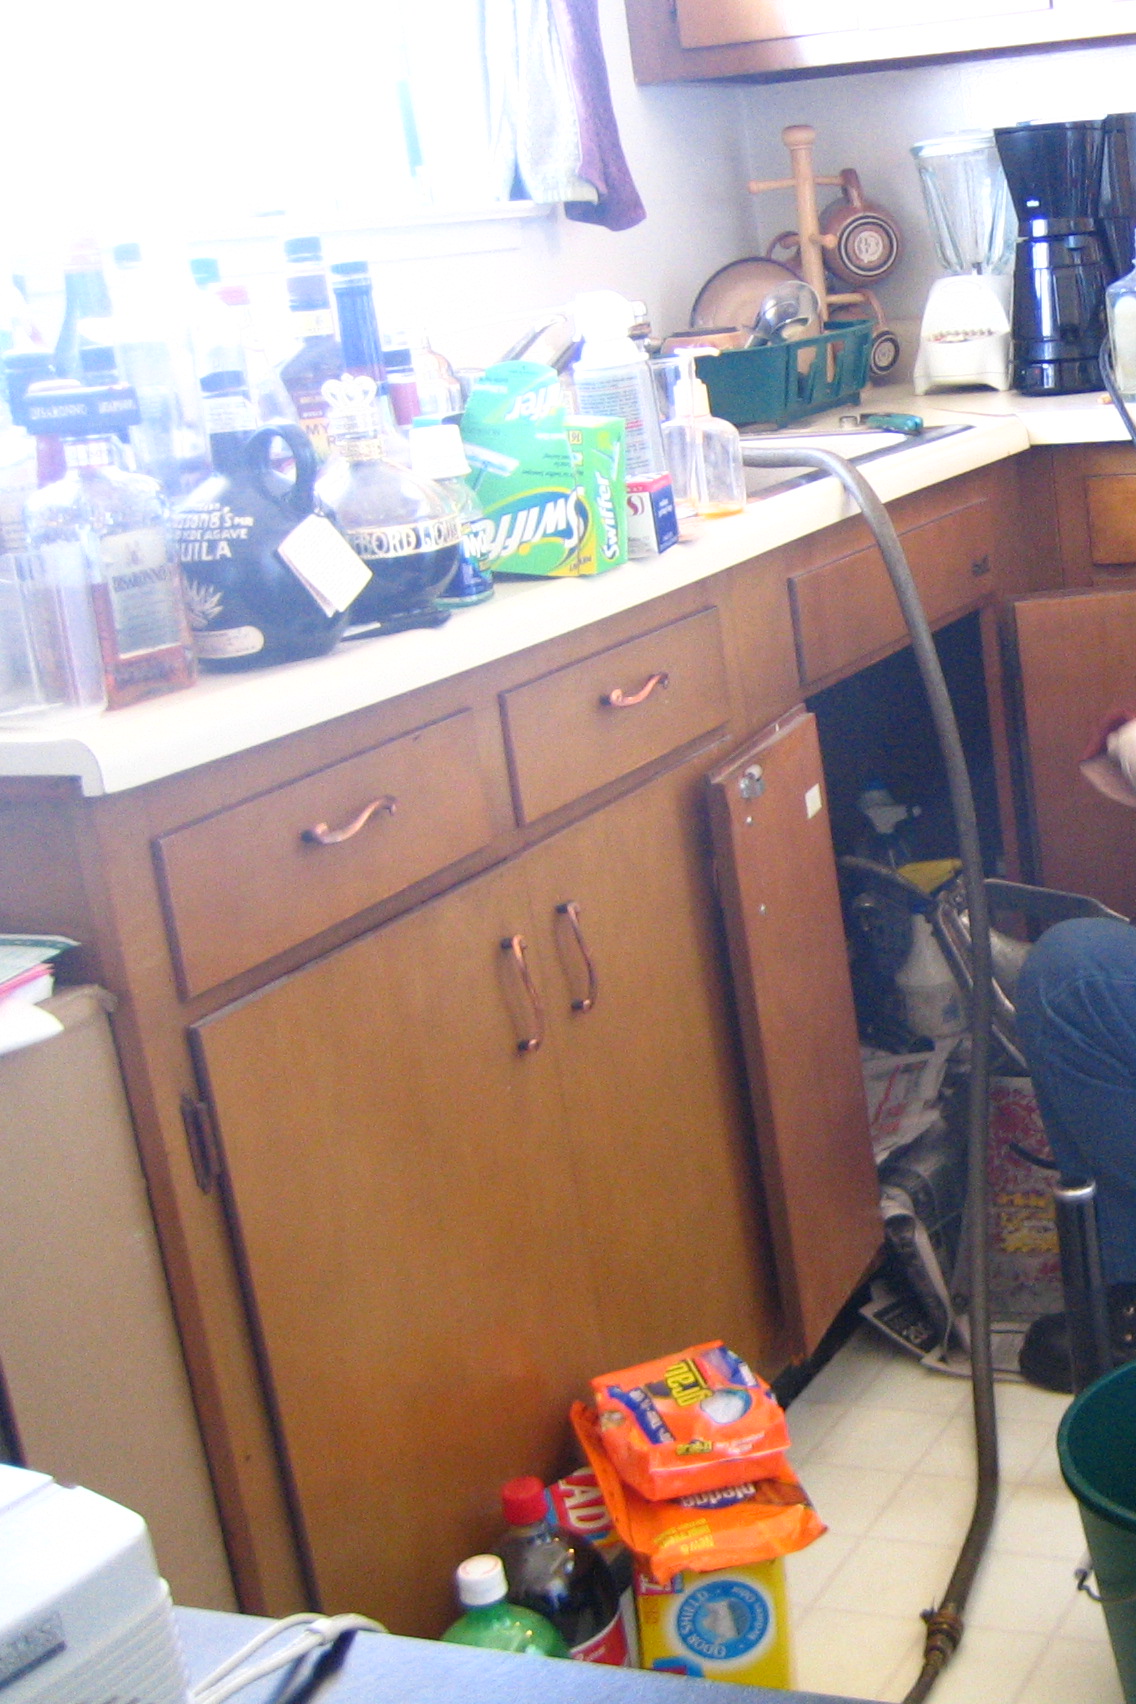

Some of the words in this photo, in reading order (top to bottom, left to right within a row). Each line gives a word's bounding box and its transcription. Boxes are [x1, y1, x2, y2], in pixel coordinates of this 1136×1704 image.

[598, 471, 621, 560] Swiffer
[179, 540, 232, 563] UILA
[678, 1590, 709, 1634] SHIELD
[686, 1633, 728, 1658] ODOR
